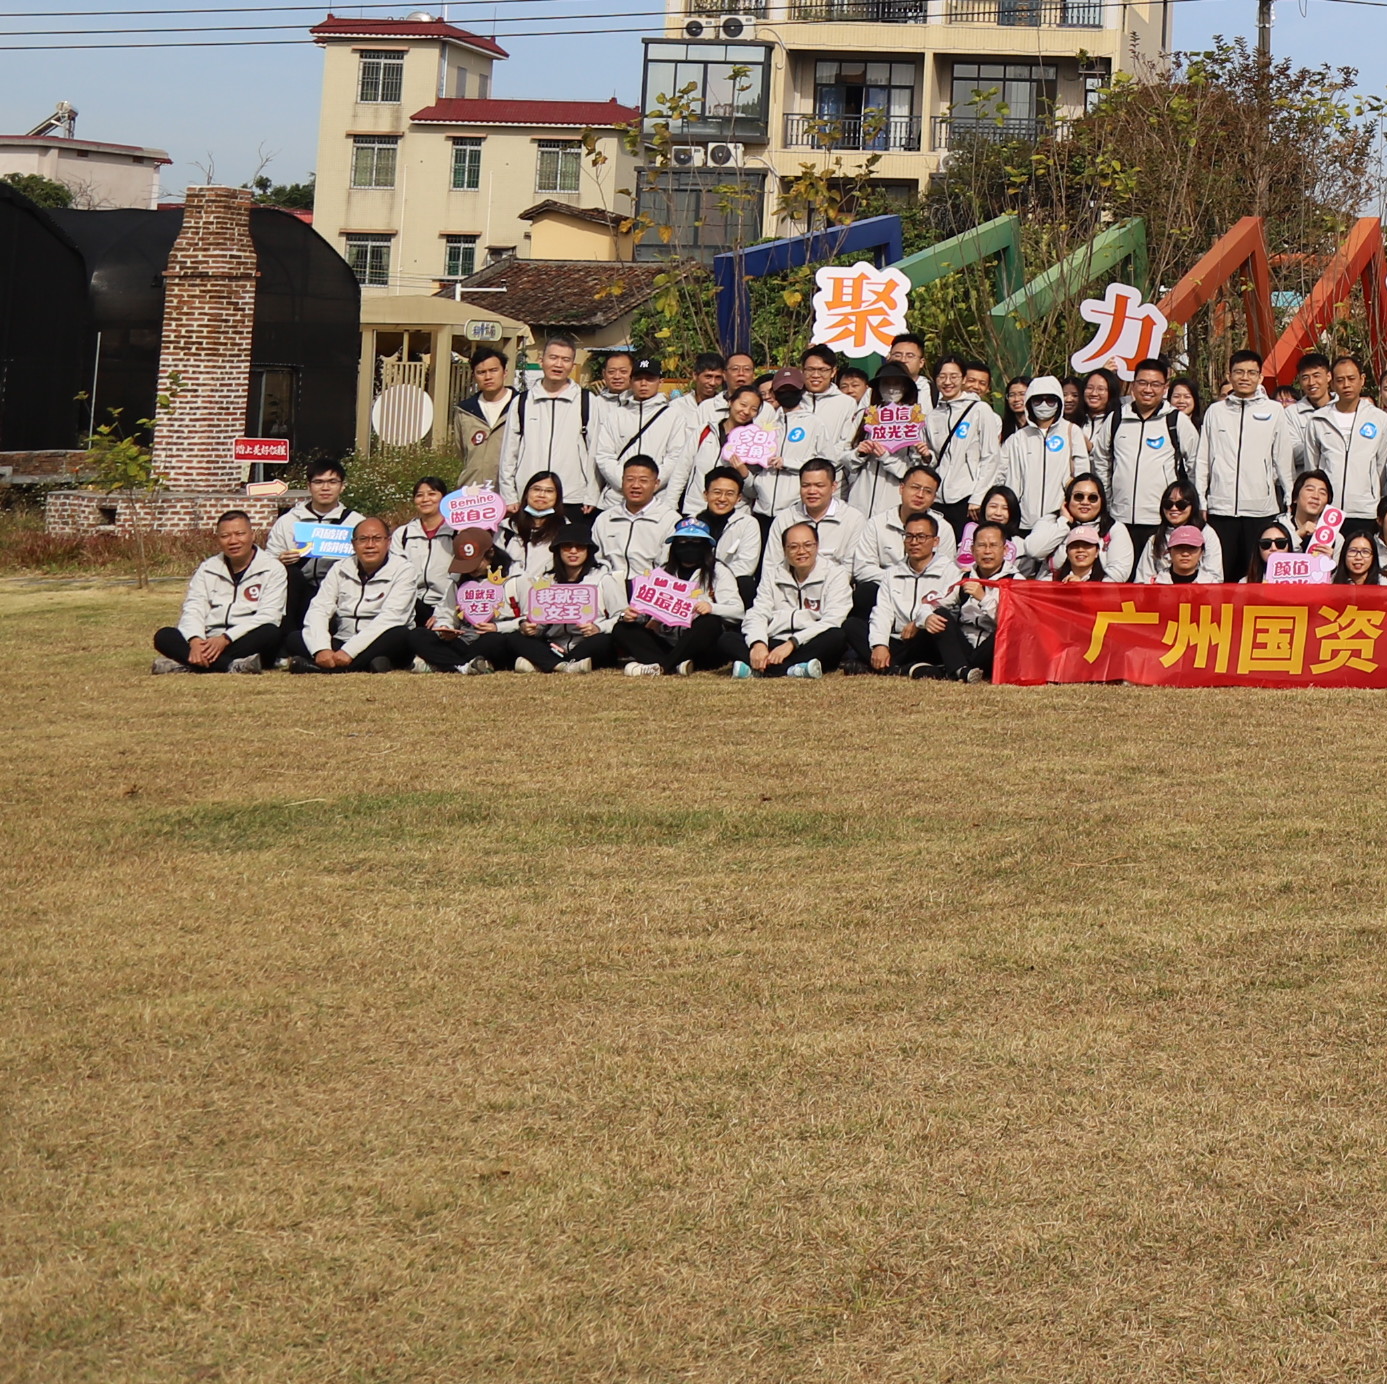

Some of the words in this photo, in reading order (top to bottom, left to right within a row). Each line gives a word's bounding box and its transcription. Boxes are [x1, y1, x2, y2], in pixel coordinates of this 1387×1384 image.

[819, 272, 901, 347] 聚
[1082, 294, 1158, 371] 力
[880, 407, 910, 421] 自信
[740, 431, 768, 445] 今日
[792, 429, 802, 440] 3
[872, 424, 918, 439] 放光芒
[959, 425, 968, 436] 3
[475, 432, 485, 445] 9
[735, 445, 764, 458] 主角
[449, 494, 494, 510] Bemine
[450, 507, 497, 525] 做自己
[463, 543, 475, 557] 9
[1274, 560, 1310, 577] 颜值
[249, 585, 261, 600] 9
[464, 589, 496, 600] 姐就是
[536, 588, 591, 605] 我就是
[469, 602, 490, 614] 女王
[636, 583, 693, 618] 姐最酷
[545, 604, 581, 621] 女王
